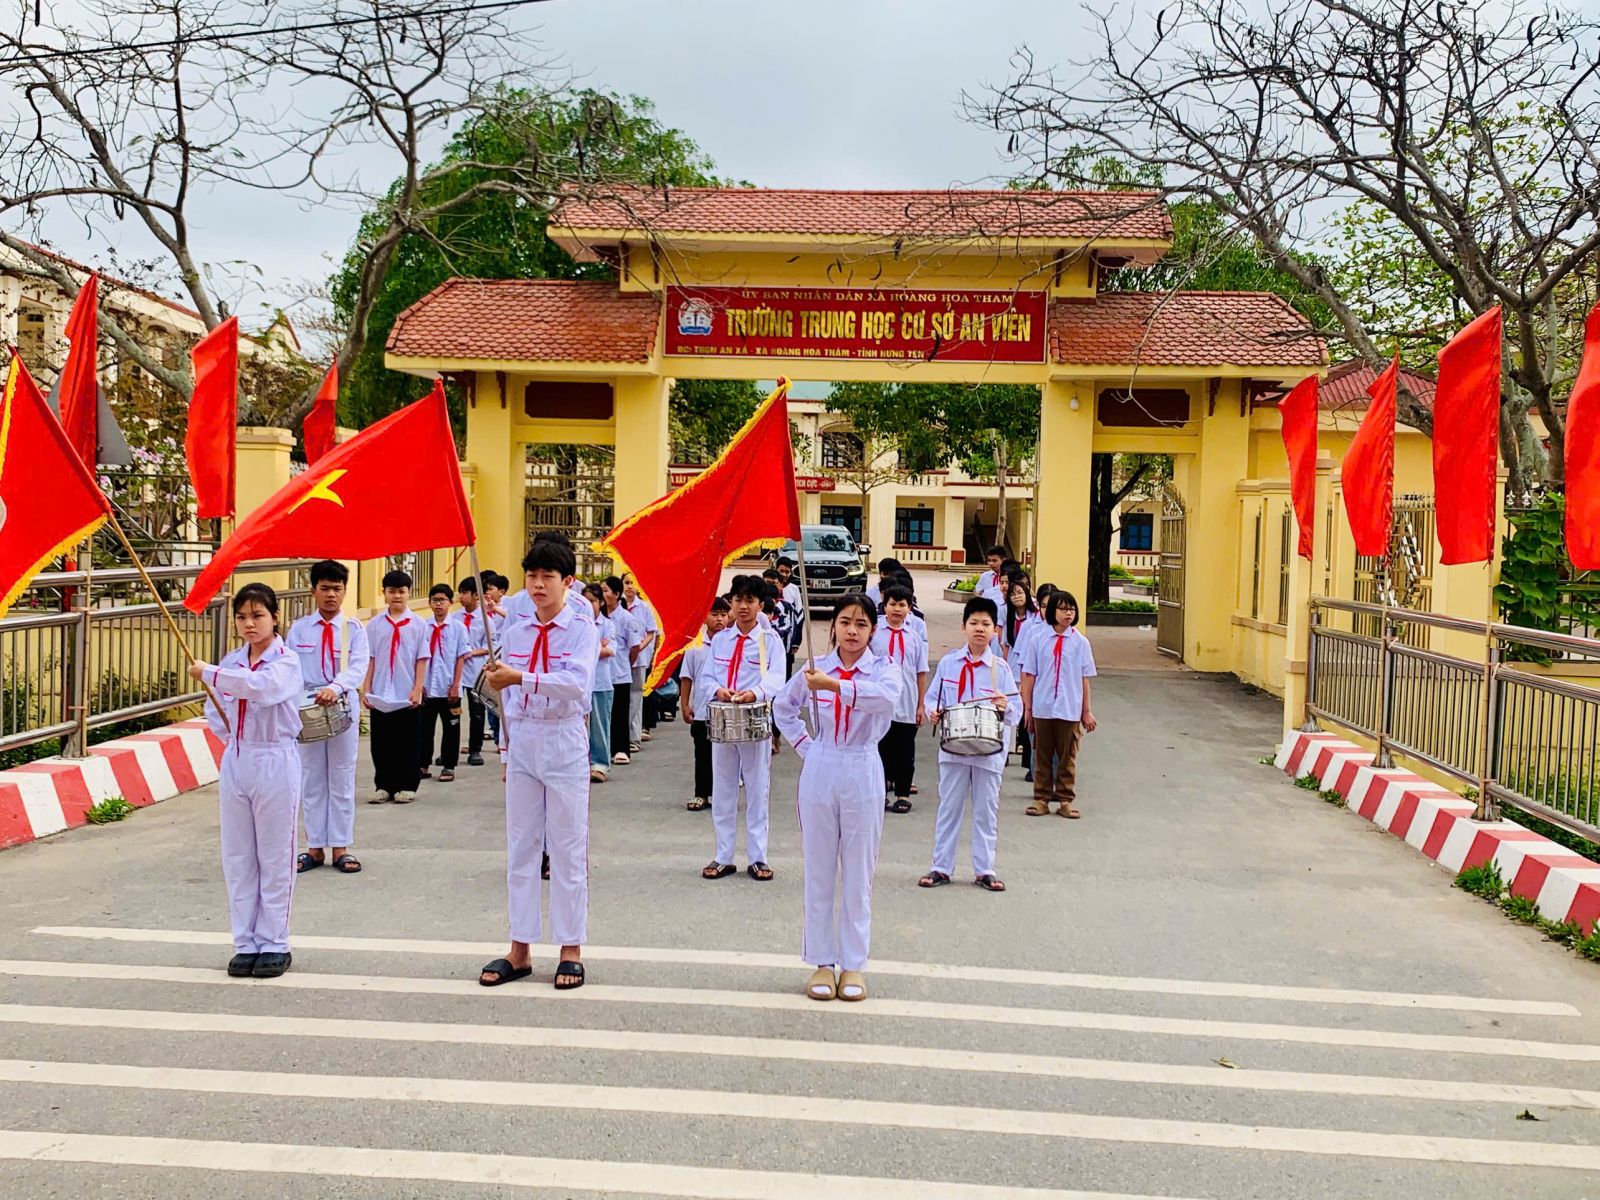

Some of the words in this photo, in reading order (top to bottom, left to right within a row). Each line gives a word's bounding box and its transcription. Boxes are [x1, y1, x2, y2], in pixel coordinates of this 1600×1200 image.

[762, 291, 790, 300] BAN
[794, 290, 832, 301] NHÂN
[836, 291, 864, 301] DÂN
[941, 293, 970, 303] HOA
[725, 302, 794, 337] TRƯỜNG
[800, 310, 857, 339] TRUNG
[861, 311, 896, 345] HỌC
[901, 309, 926, 340] CƠ
[931, 302, 955, 341] SỞ
[959, 312, 986, 342] AN
[991, 307, 1032, 342] VIÊN
[719, 346, 734, 355] AN
[803, 348, 822, 357] HOA
